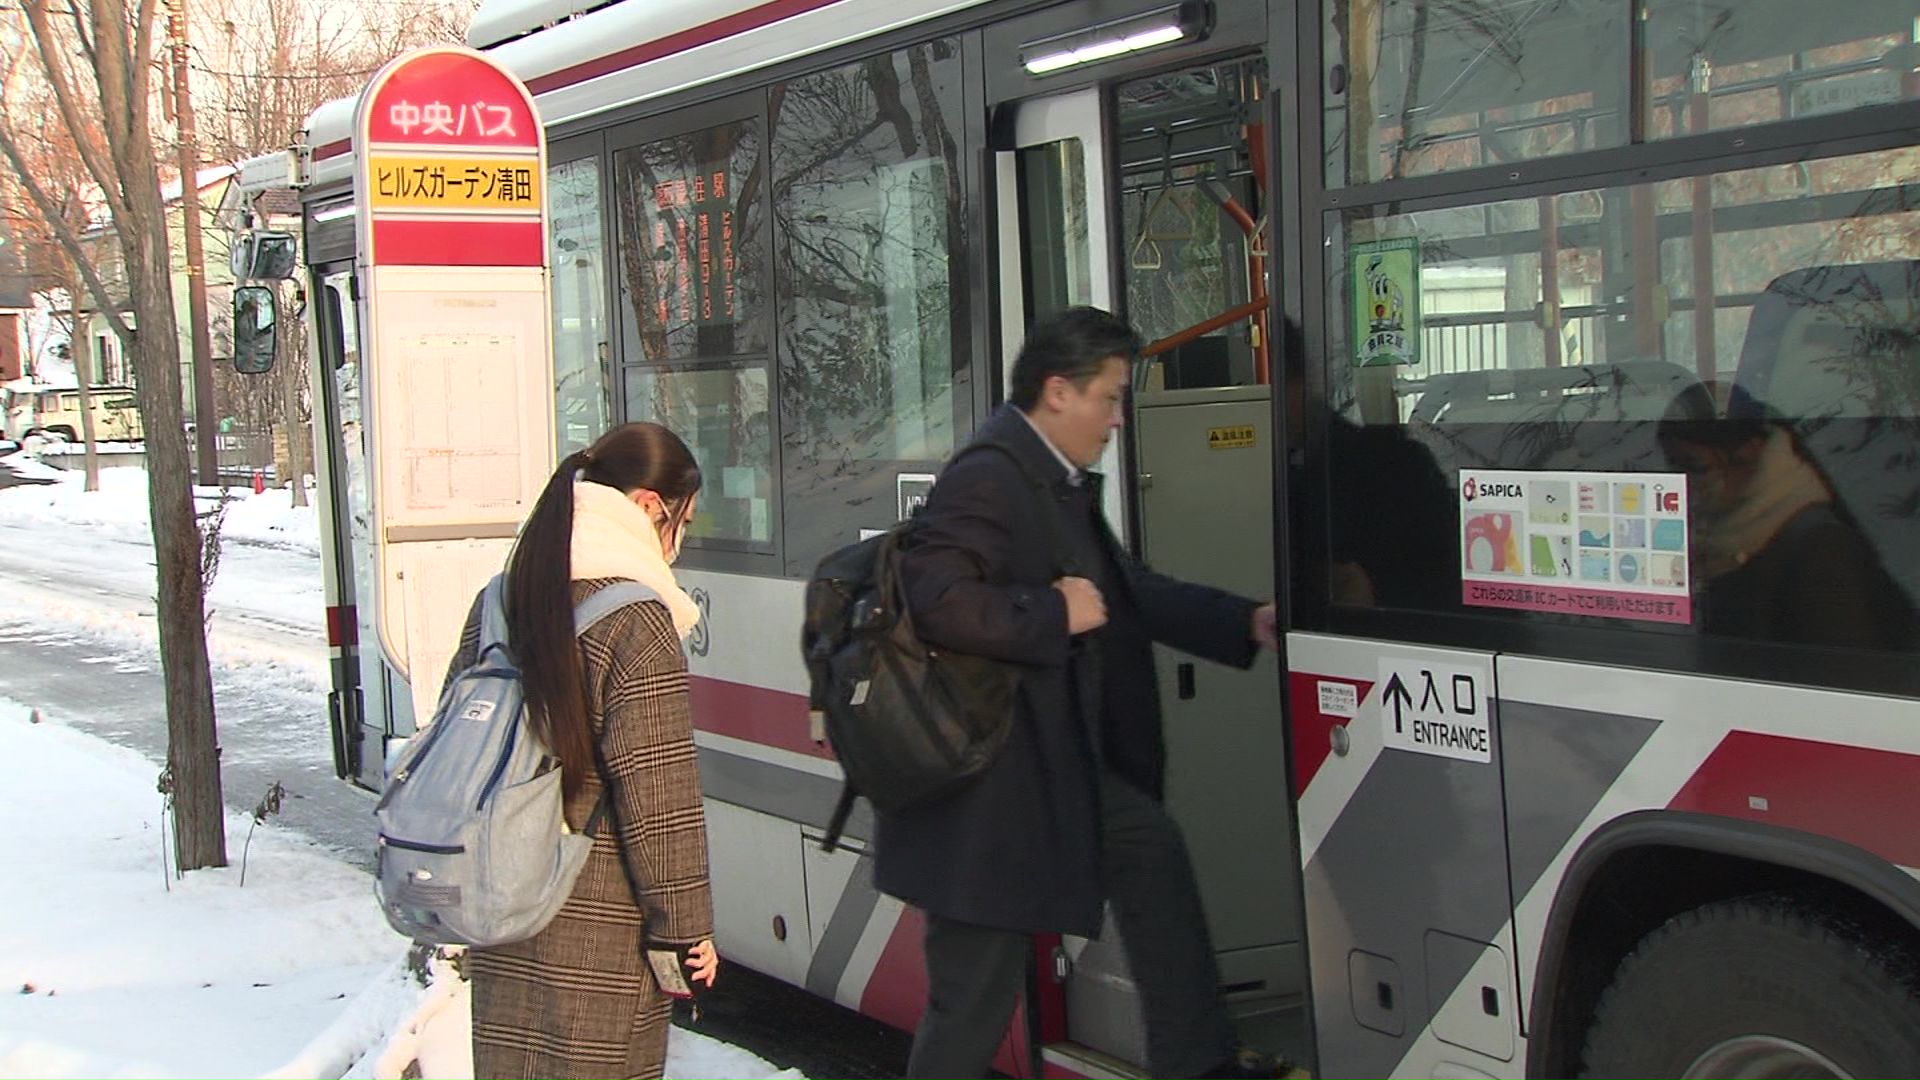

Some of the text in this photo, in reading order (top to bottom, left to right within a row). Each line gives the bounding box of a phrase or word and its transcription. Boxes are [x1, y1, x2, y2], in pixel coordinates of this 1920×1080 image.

[389, 100, 516, 137] 中央バス
[378, 166, 531, 201] ヒルズガーデン清田
[1480, 484, 1523, 498] SAPICA
[1420, 670, 1476, 715] 入口
[1413, 720, 1488, 752] ENTRANCE
